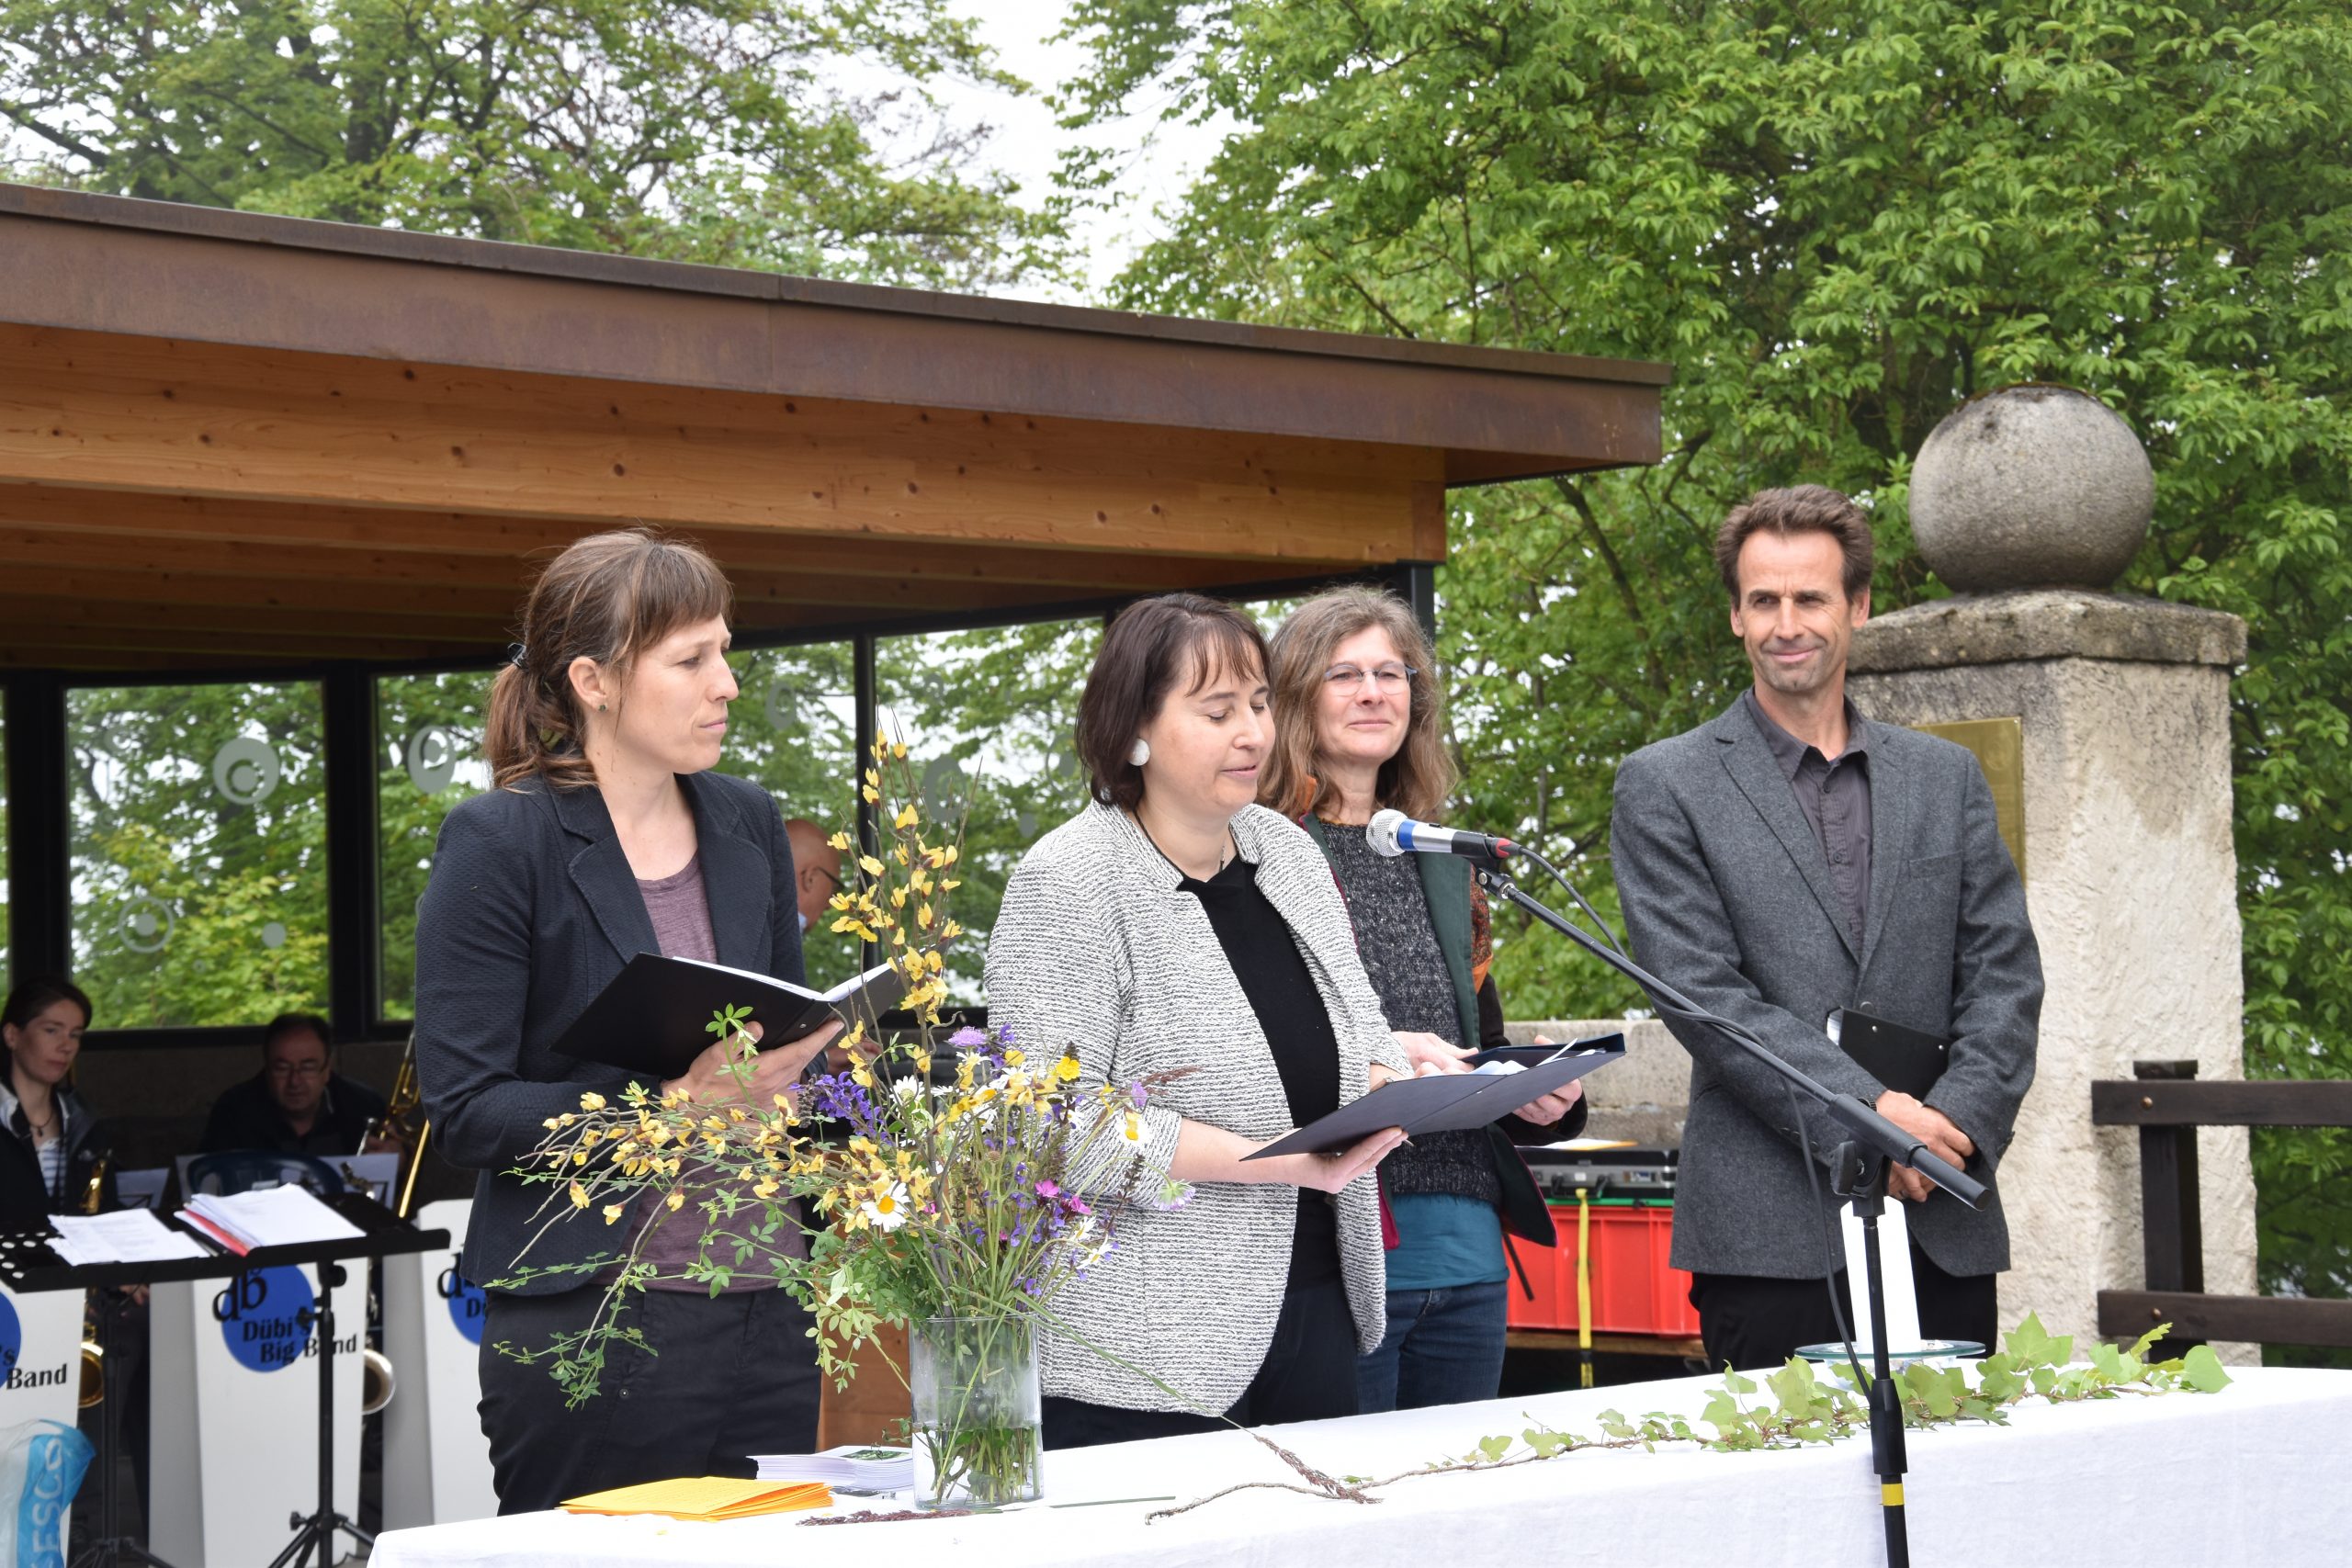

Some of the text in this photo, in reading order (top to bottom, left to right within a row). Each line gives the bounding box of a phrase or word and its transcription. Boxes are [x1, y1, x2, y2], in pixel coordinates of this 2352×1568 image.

[260, 1334, 357, 1366] Big Bnd
[6, 1363, 68, 1390] Band
[31, 1437, 63, 1568] ESCO
